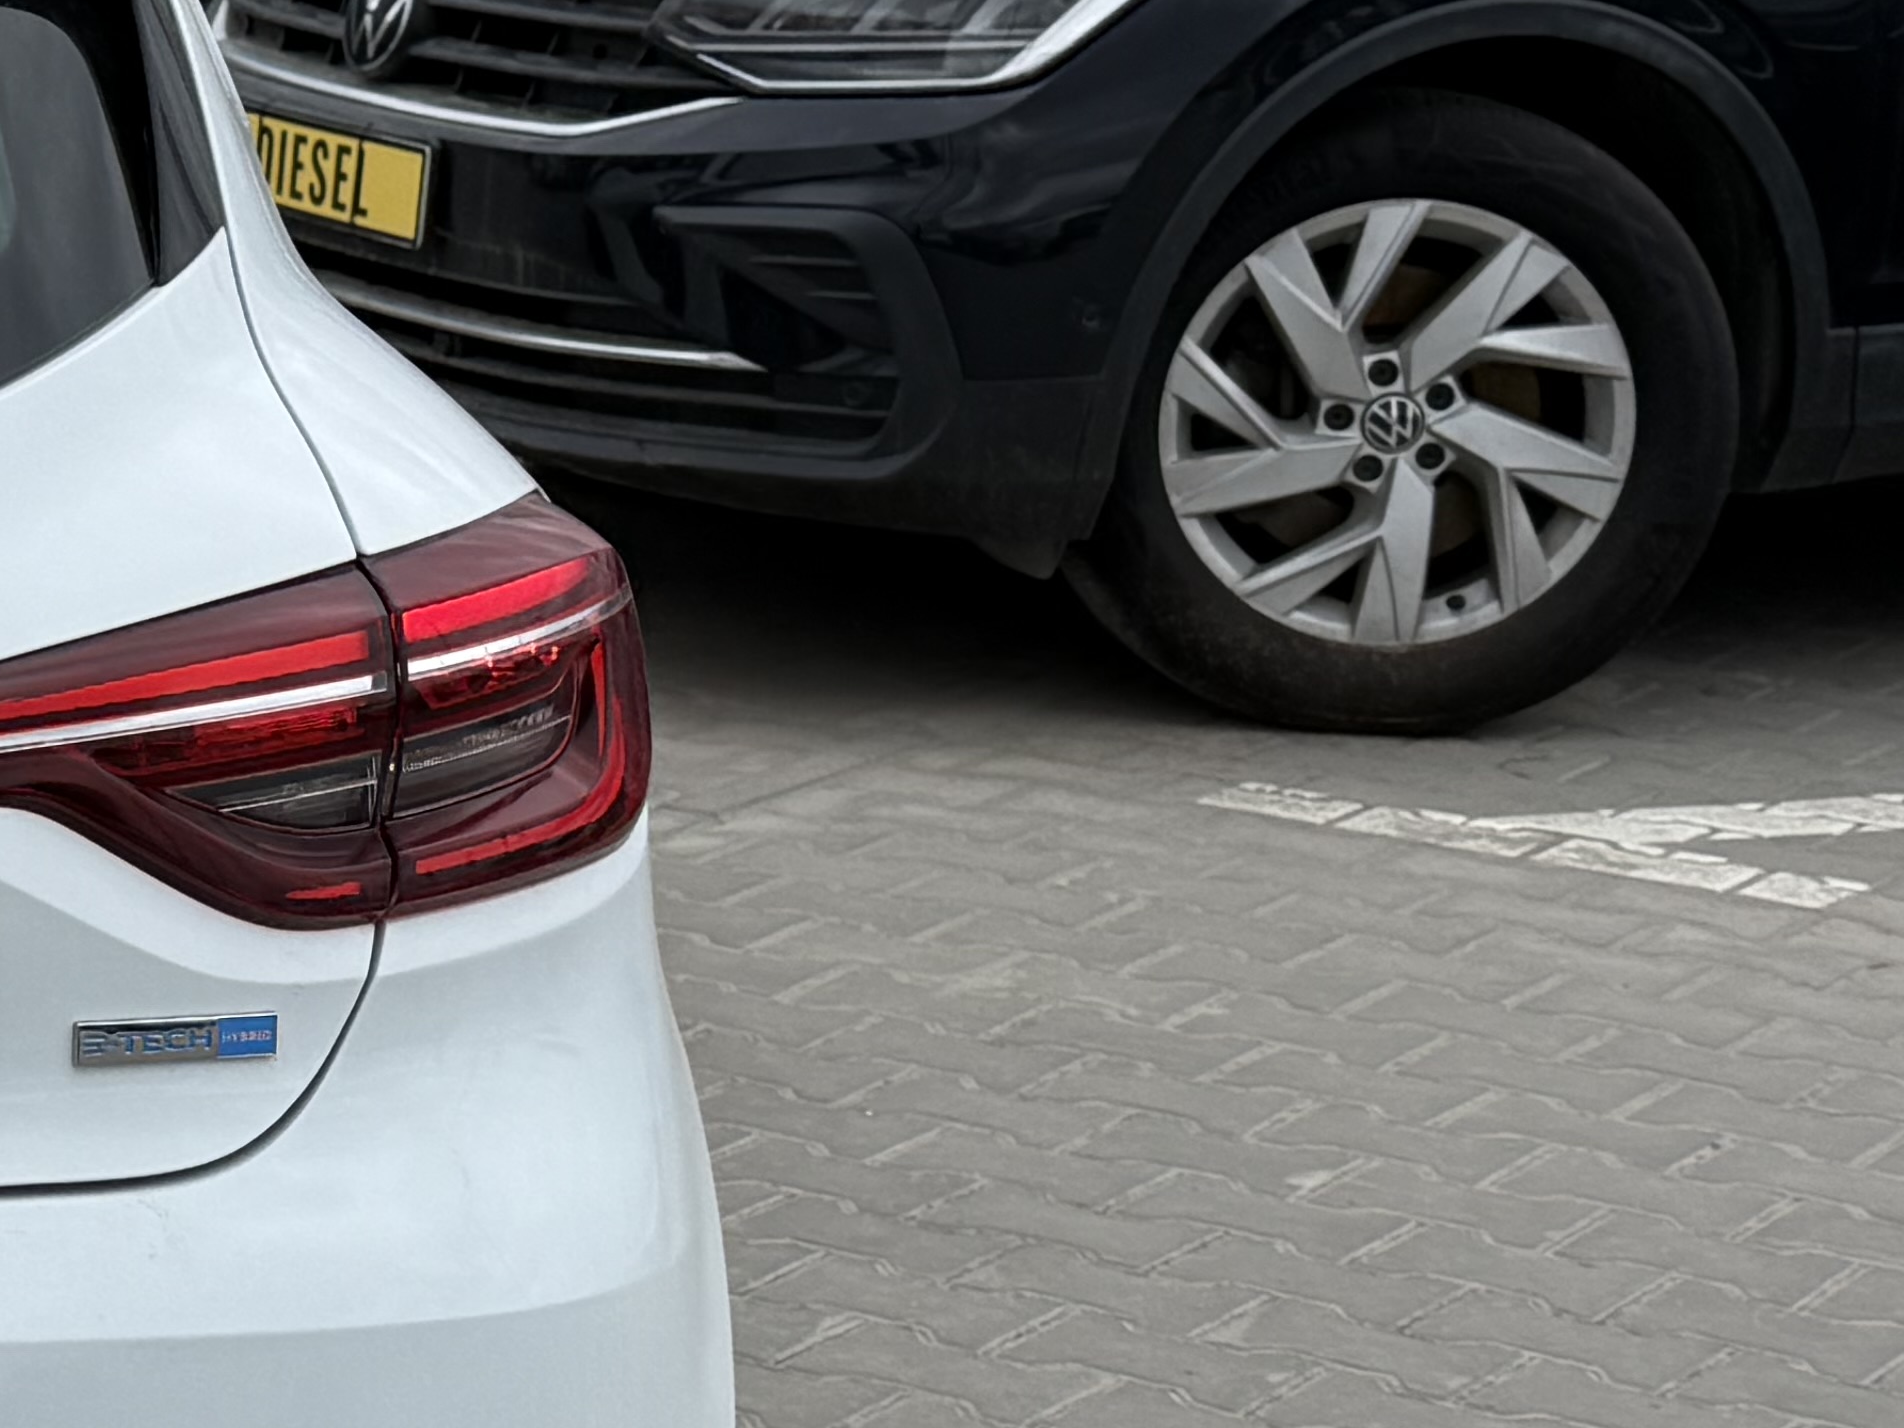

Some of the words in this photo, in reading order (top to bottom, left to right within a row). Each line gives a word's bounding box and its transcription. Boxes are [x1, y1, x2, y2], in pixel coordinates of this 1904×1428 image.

[258, 125, 368, 218] DIESEL
[80, 1028, 213, 1058] E-TECH
[221, 1028, 274, 1044] HYBRID
